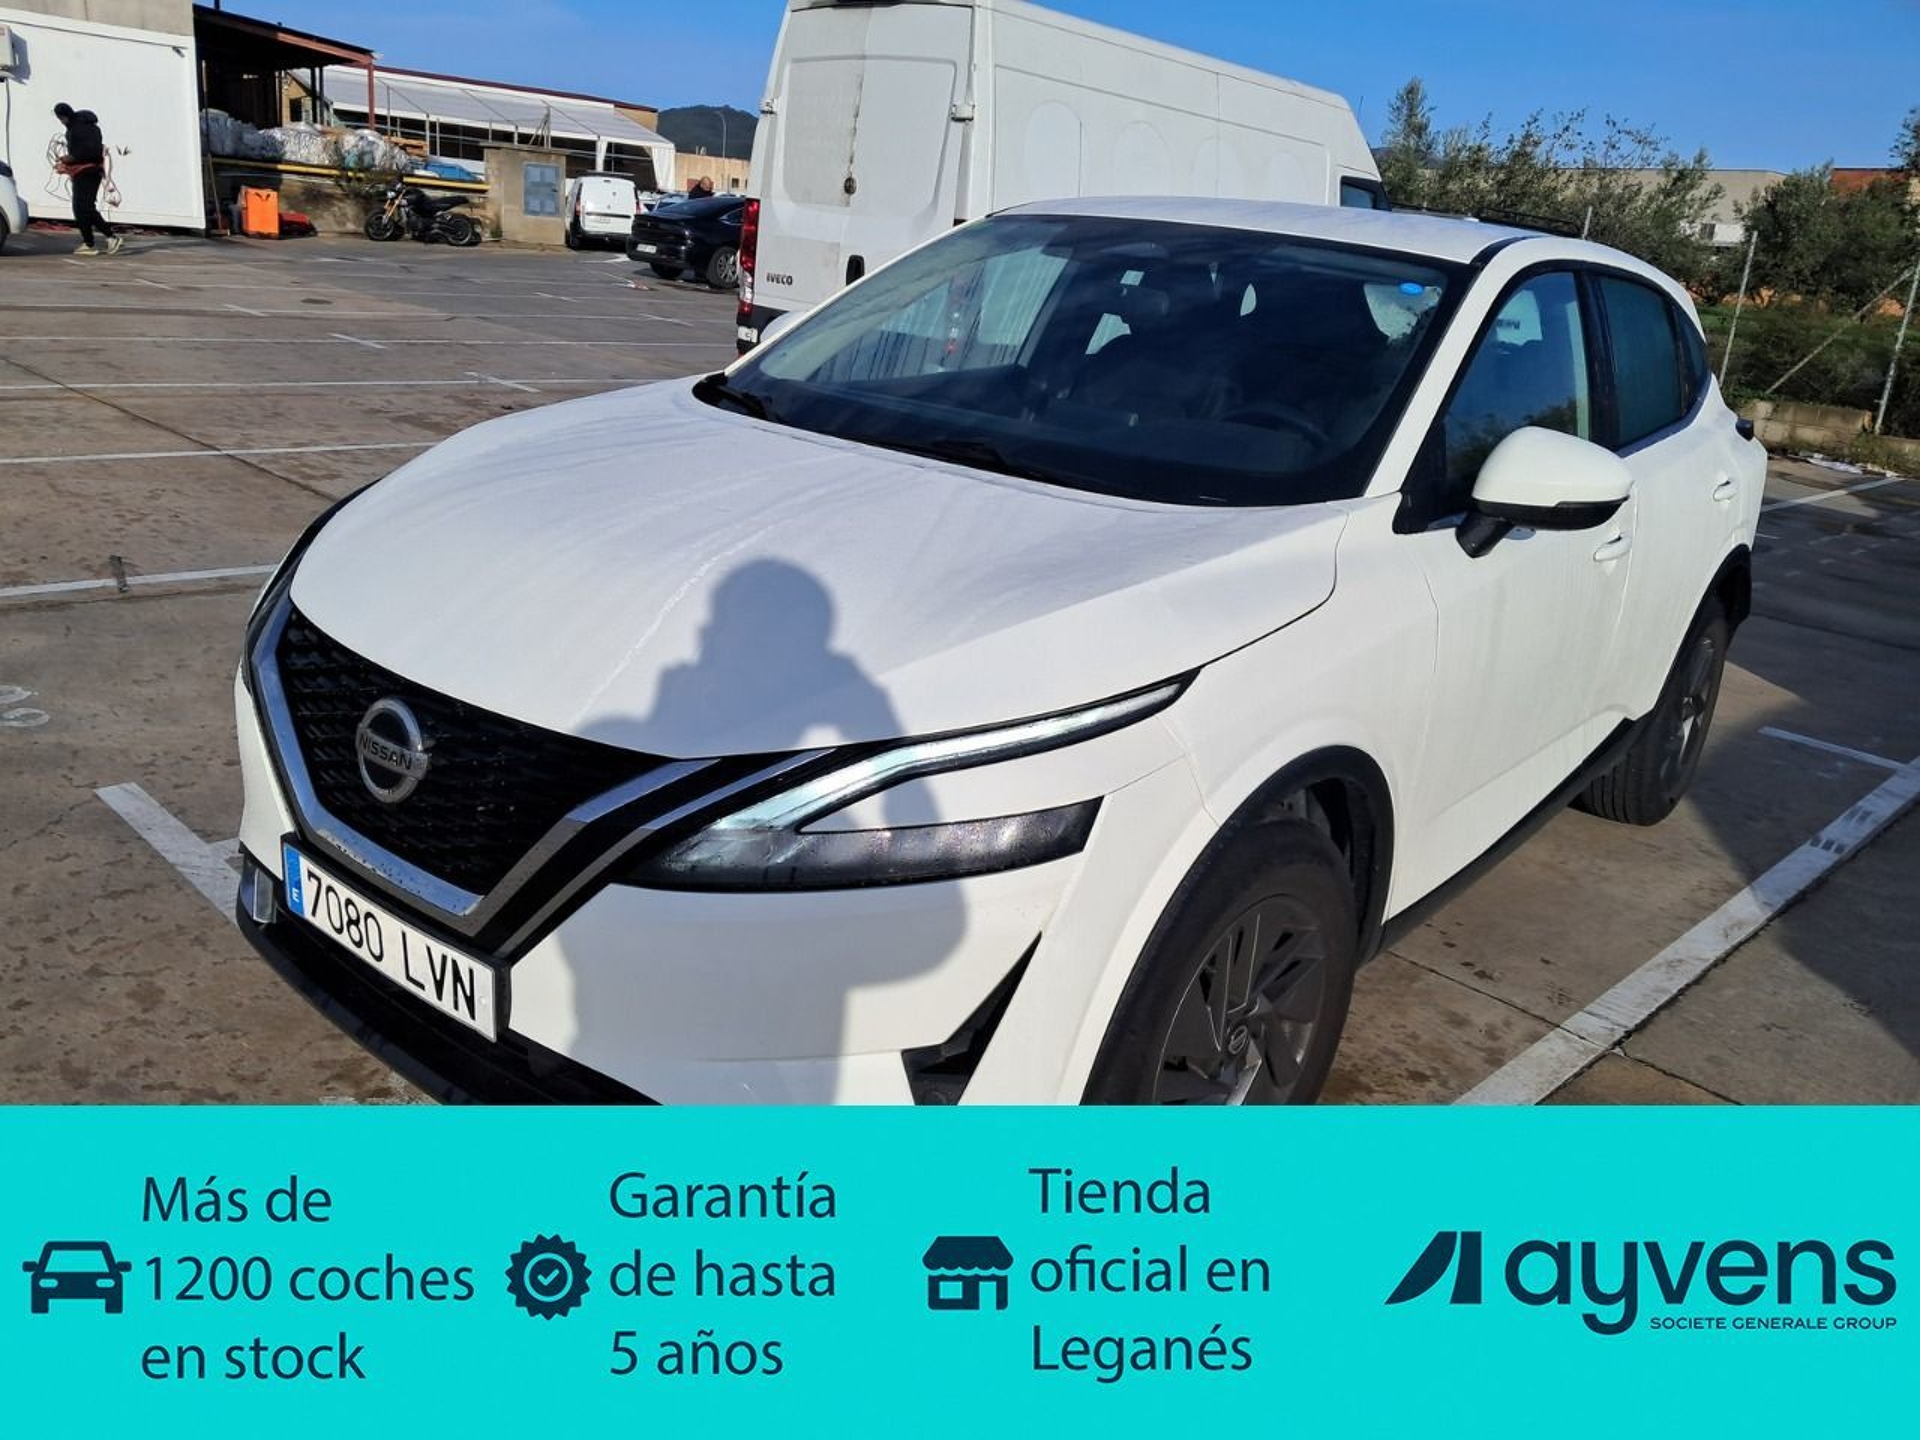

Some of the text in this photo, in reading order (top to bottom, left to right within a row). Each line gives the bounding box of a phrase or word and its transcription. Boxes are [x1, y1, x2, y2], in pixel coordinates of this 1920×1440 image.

[766, 272, 794, 286] IVECO
[359, 731, 413, 770] NISSAN
[291, 887, 301, 903] E
[306, 868, 477, 1022] 7080 LVN
